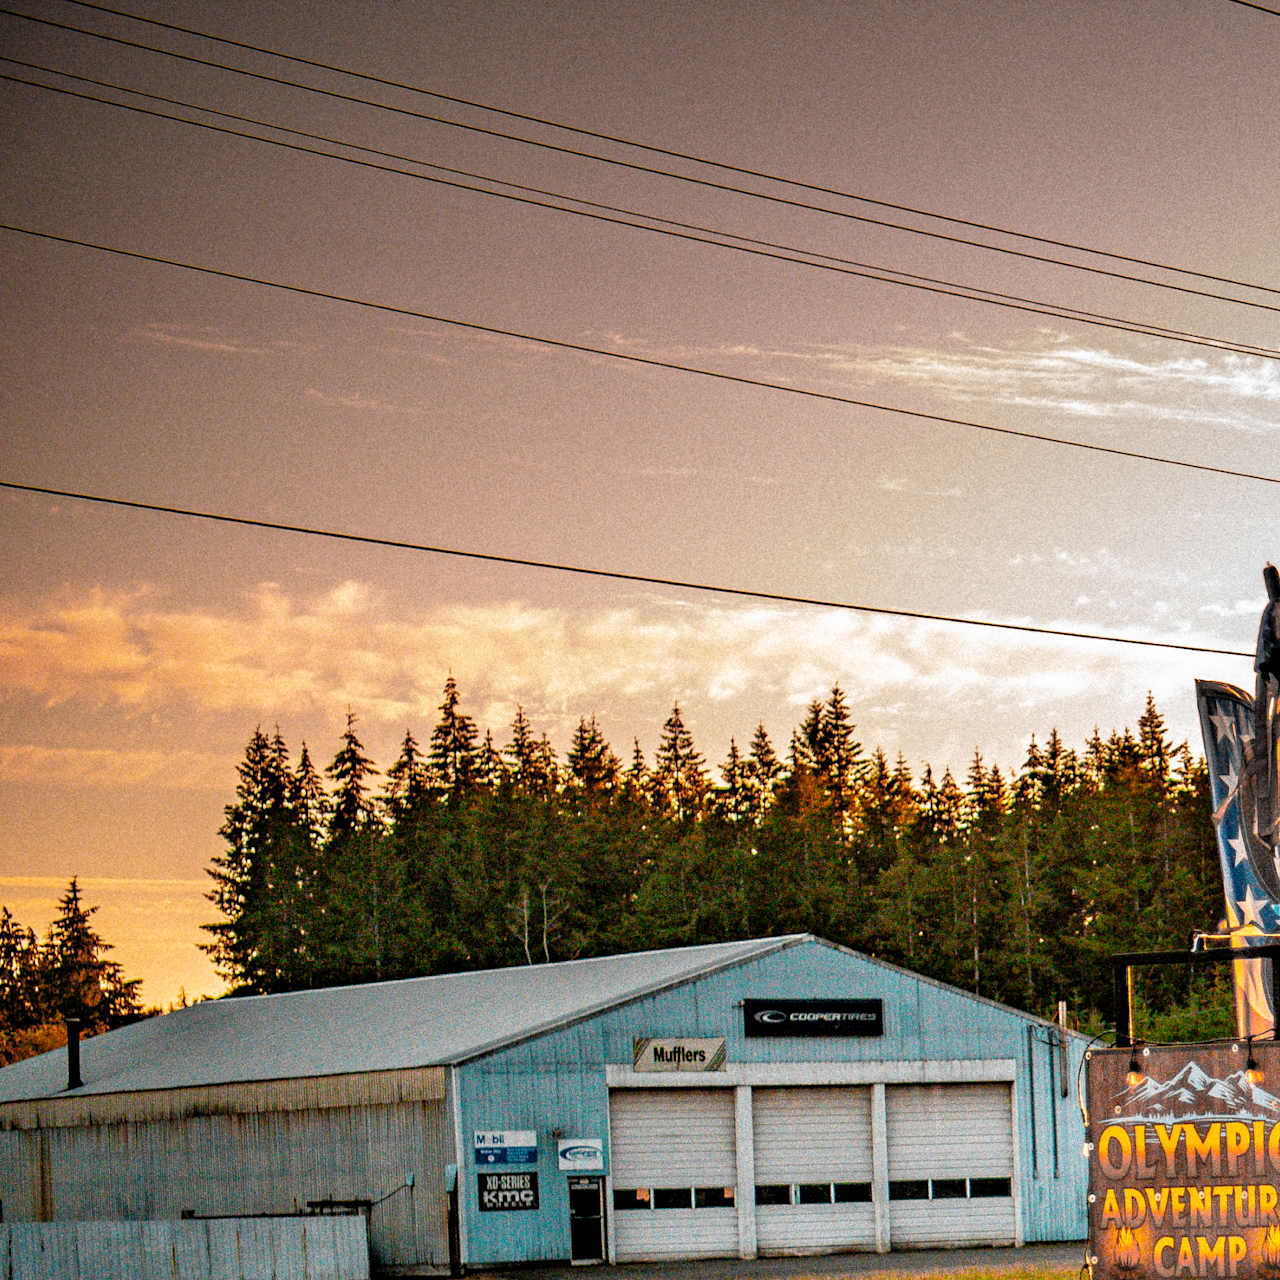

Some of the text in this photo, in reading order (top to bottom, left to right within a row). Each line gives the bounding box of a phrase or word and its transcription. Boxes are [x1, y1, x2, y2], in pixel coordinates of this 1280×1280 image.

[653, 1047, 706, 1063] Mufflers
[476, 1134, 505, 1145] Mbil
[1153, 1235, 1248, 1278] CAMP
